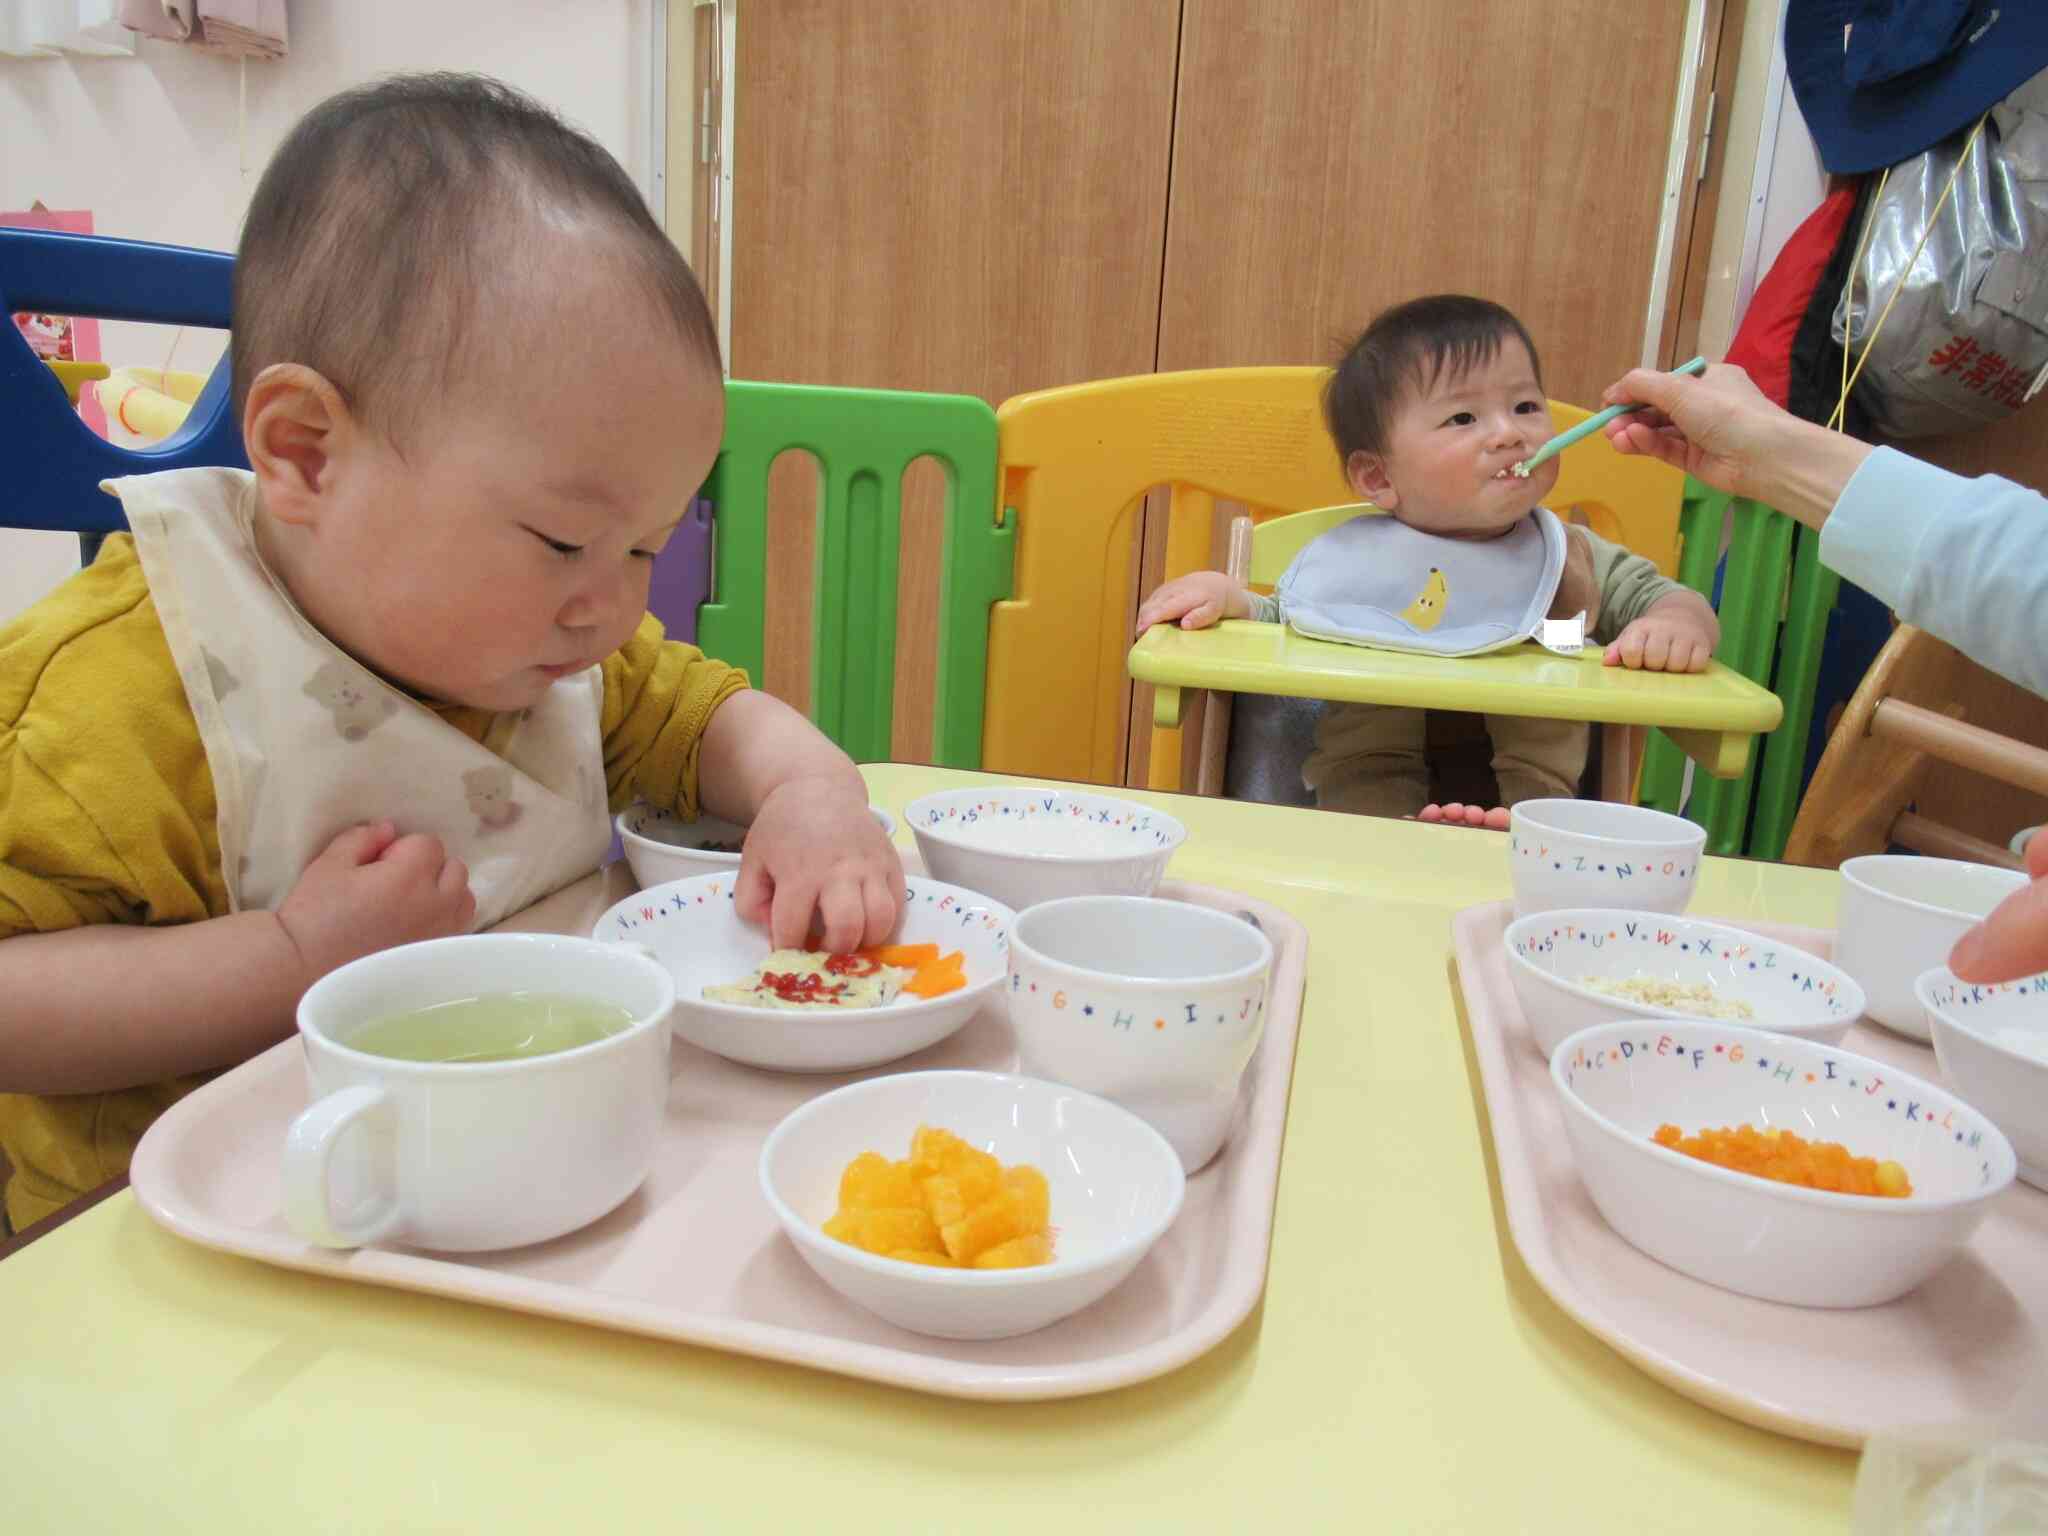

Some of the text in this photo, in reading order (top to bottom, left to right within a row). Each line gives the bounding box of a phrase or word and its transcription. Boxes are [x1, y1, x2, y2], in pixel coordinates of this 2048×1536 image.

[1043, 799, 1054, 812] V
[1099, 809, 1110, 823] X
[1573, 856, 1587, 872] Z
[1616, 863, 1633, 879] N
[671, 893, 687, 911] X
[961, 912, 974, 927] F
[1626, 922, 1638, 937] V
[1699, 939, 1713, 955] X
[1764, 952, 1777, 968] Z
[1802, 977, 1813, 992] A
[1113, 1010, 1134, 1031] H
[1184, 1003, 1198, 1023] I
[1620, 1041, 1634, 1058] D
[1656, 1035, 1673, 1057] E
[1692, 1050, 1704, 1070] F
[1728, 1043, 1745, 1063] G
[1773, 1062, 1794, 1083] H
[1824, 1061, 1837, 1079] I
[1865, 1078, 1884, 1095] J
[1906, 1101, 1920, 1121] K
